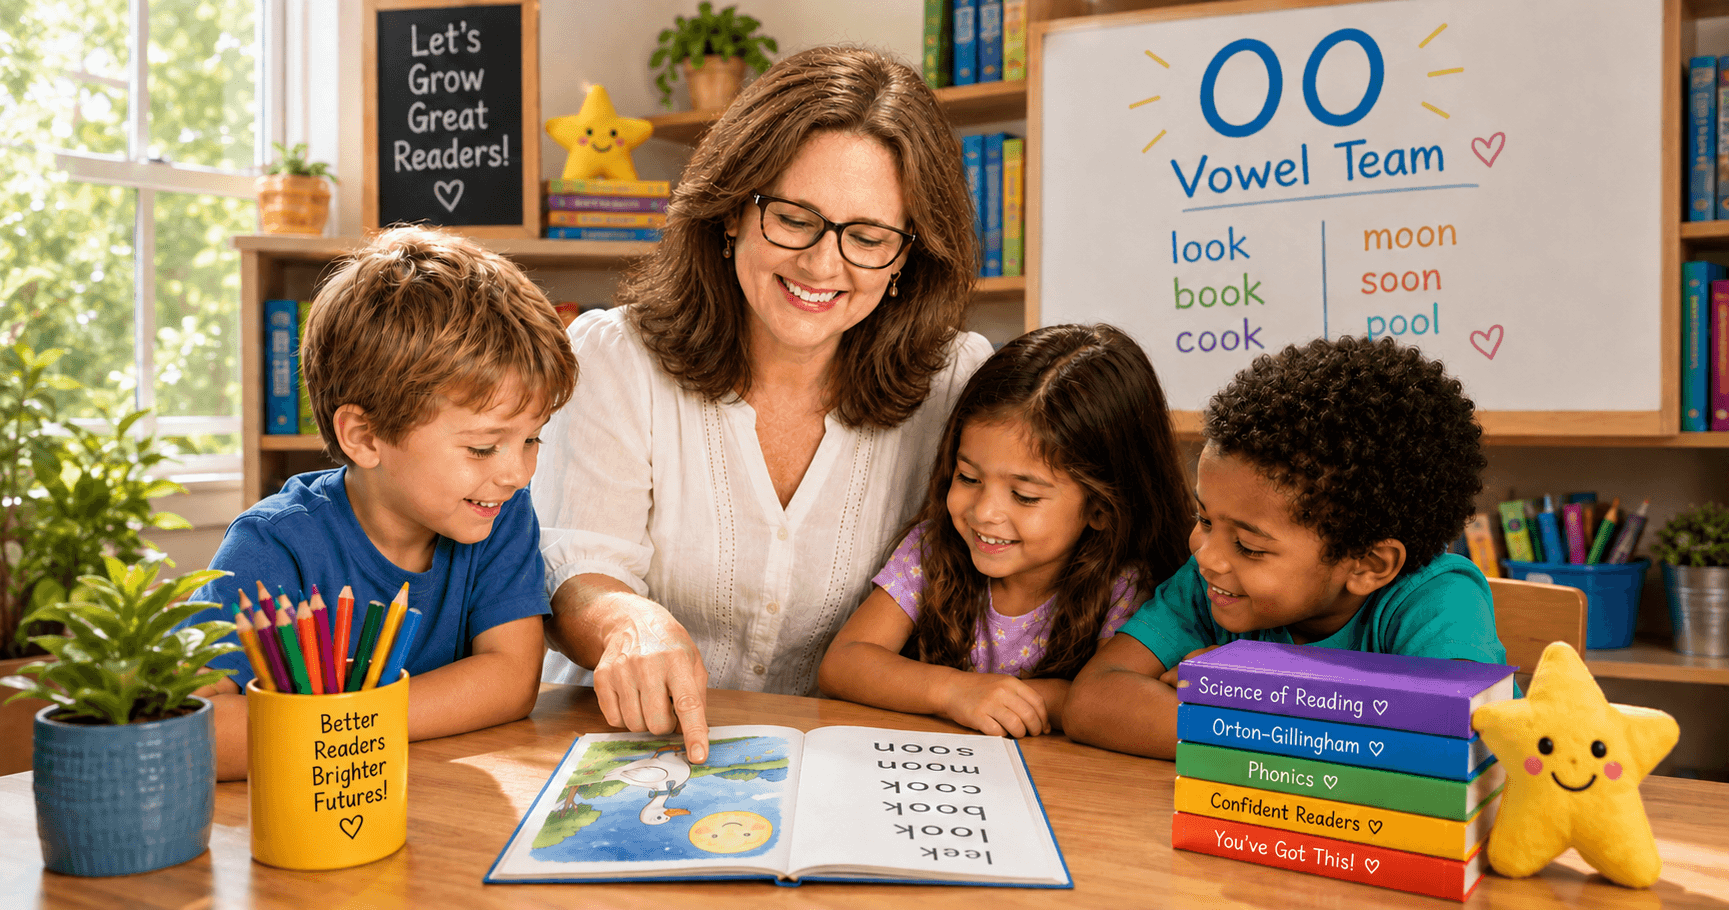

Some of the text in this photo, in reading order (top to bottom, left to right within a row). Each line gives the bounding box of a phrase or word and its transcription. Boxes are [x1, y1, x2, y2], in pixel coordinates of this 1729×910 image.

[411, 20, 481, 57] Let's
[408, 63, 485, 95] Grow
[407, 100, 488, 134] Great
[394, 134, 509, 172] Readers!
[1171, 139, 1444, 198] Vowel Team
[1172, 226, 1251, 264] look
[1364, 224, 1457, 252] moon
[1174, 272, 1265, 310] book
[1361, 269, 1442, 295] soon
[1177, 317, 1266, 354] cook
[1367, 302, 1440, 342] pool
[1198, 676, 1364, 719] Science of Reading
[321, 712, 379, 734] Better
[1212, 717, 1360, 755] Orton-Gillingham
[314, 735, 385, 760] Readers
[874, 741, 974, 757] soon
[312, 761, 387, 788] Brighter
[877, 760, 979, 775] moon
[1248, 760, 1314, 787] Phonics
[314, 779, 387, 812] Futures!
[880, 780, 981, 795] cook
[882, 801, 987, 821] book
[1211, 792, 1360, 831] Confident Readers
[893, 824, 988, 843] look
[920, 847, 993, 865] leek
[1215, 829, 1355, 871] You've Got This!
